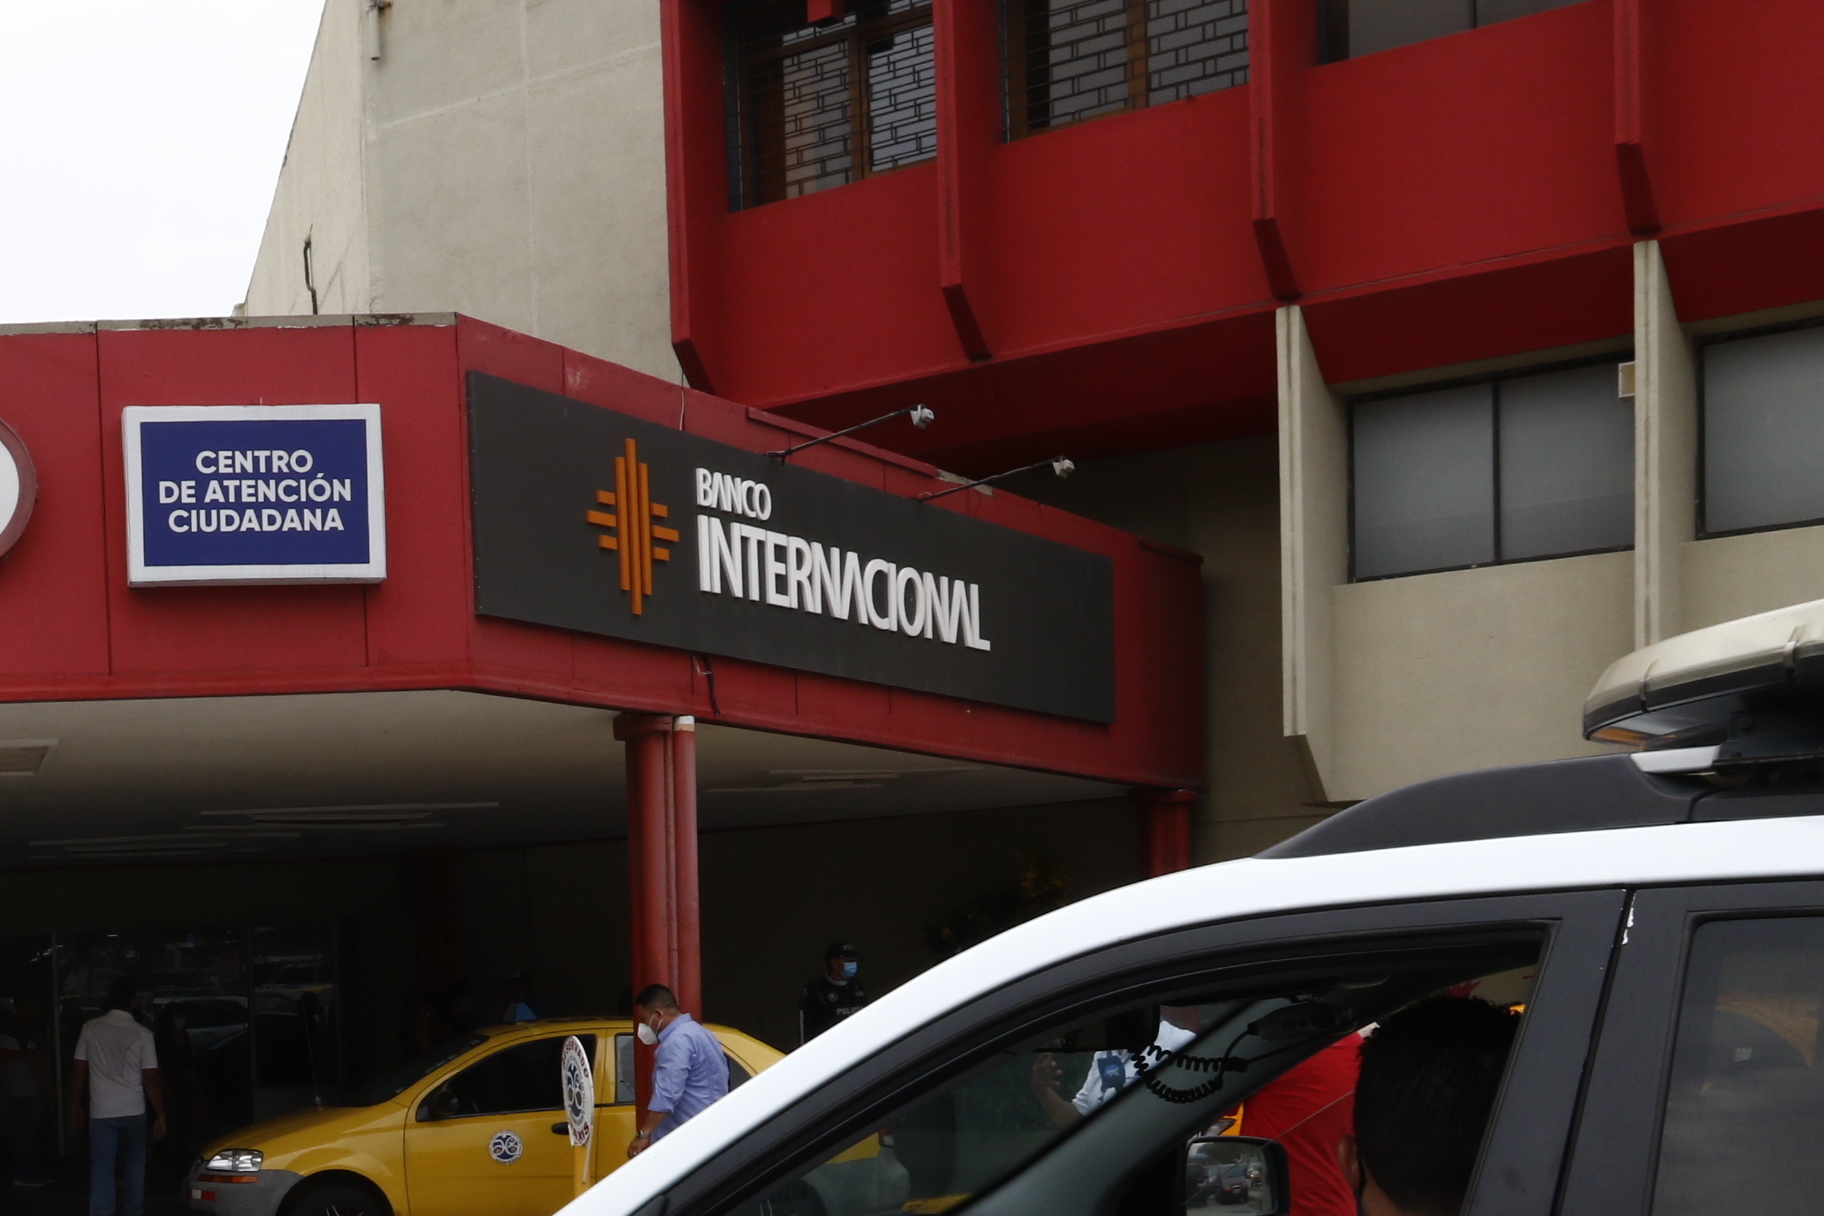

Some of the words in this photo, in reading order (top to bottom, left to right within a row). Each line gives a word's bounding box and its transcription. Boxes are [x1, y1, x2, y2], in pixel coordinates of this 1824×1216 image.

[195, 449, 314, 474] CENTRO
[159, 480, 196, 504] DE
[204, 473, 352, 503] ATENCIÓN
[695, 467, 772, 521] BANCO
[168, 508, 345, 533] CIUDADANA
[697, 514, 991, 651] INTERNACIONAL
